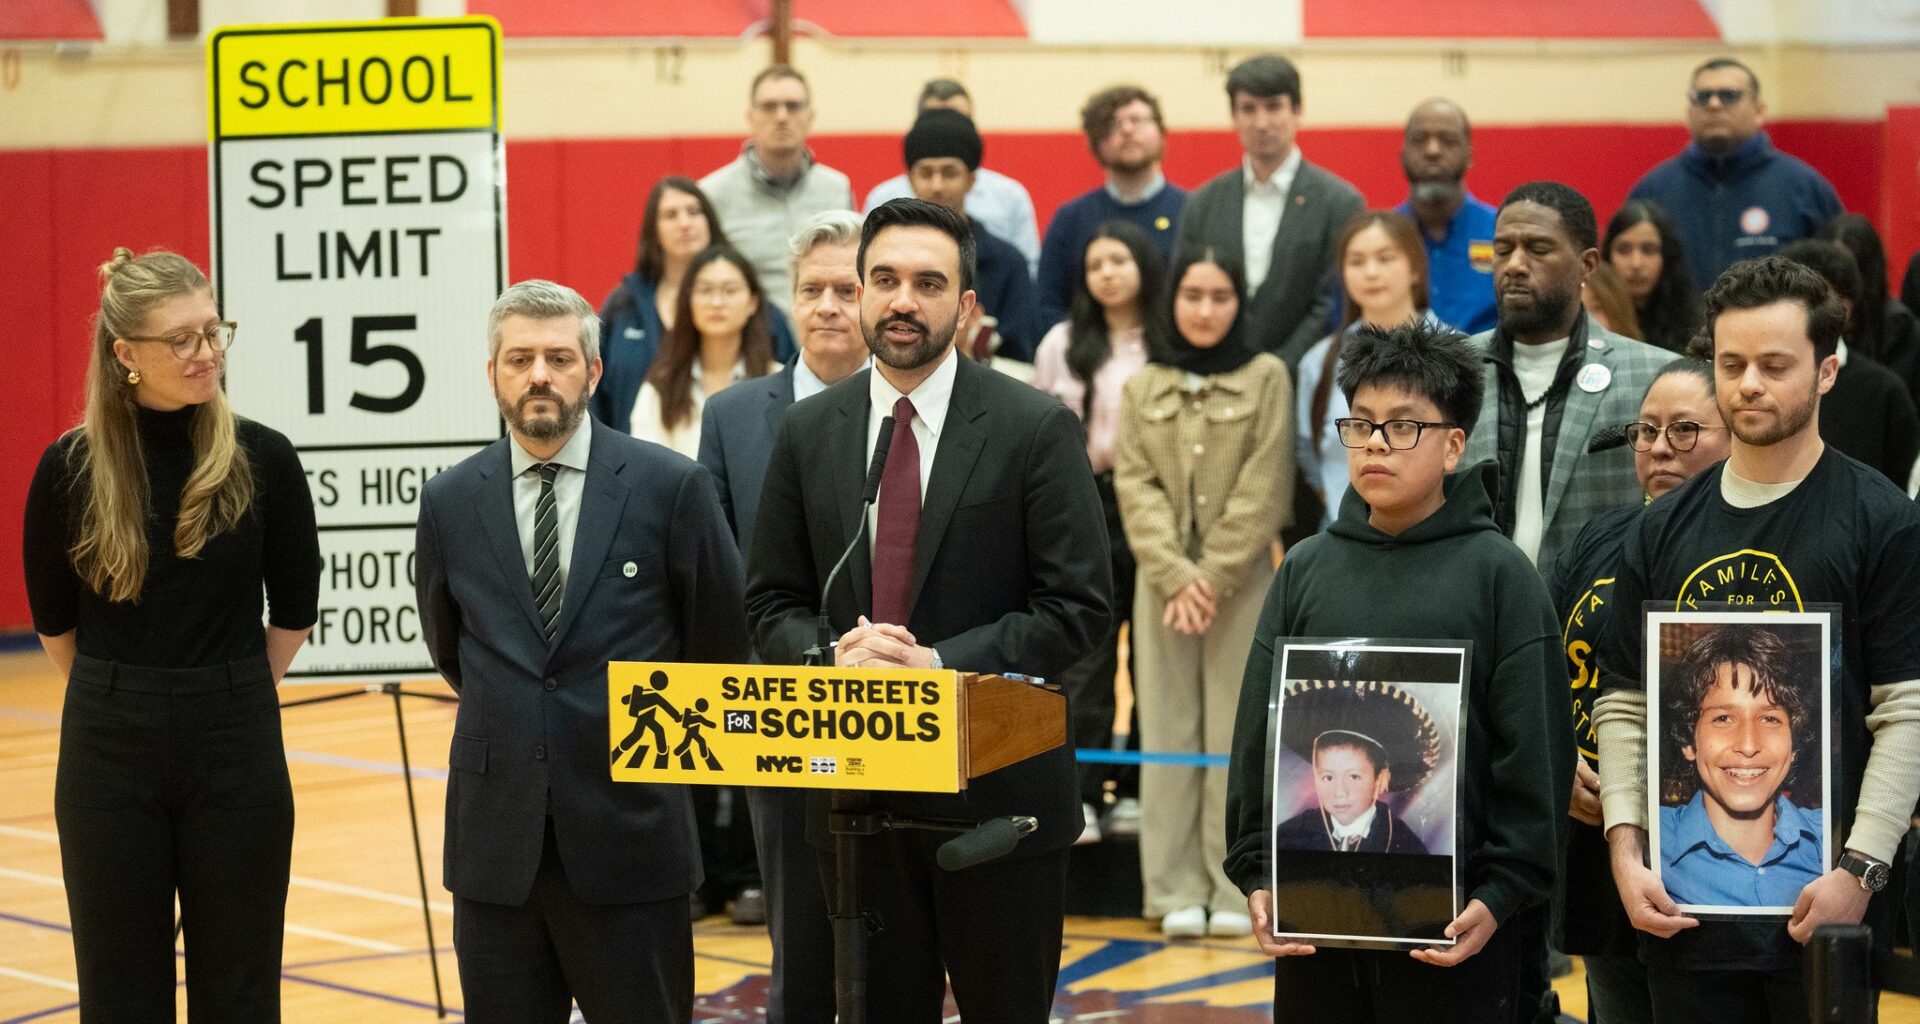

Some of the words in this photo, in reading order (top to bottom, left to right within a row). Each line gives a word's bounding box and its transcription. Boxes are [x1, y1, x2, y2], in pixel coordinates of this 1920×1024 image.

[238, 55, 473, 110] SCHOOL
[248, 155, 468, 209] SPEED
[275, 228, 441, 281] LIMIT
[294, 314, 426, 415] 15
[1727, 594, 1755, 606] FOR
[308, 605, 427, 645] FORC
[721, 676, 797, 702] SAFE
[807, 678, 940, 706] STREETS
[726, 710, 753, 730] FOR
[760, 707, 941, 743] SCHOOLS
[756, 755, 803, 773] NYC
